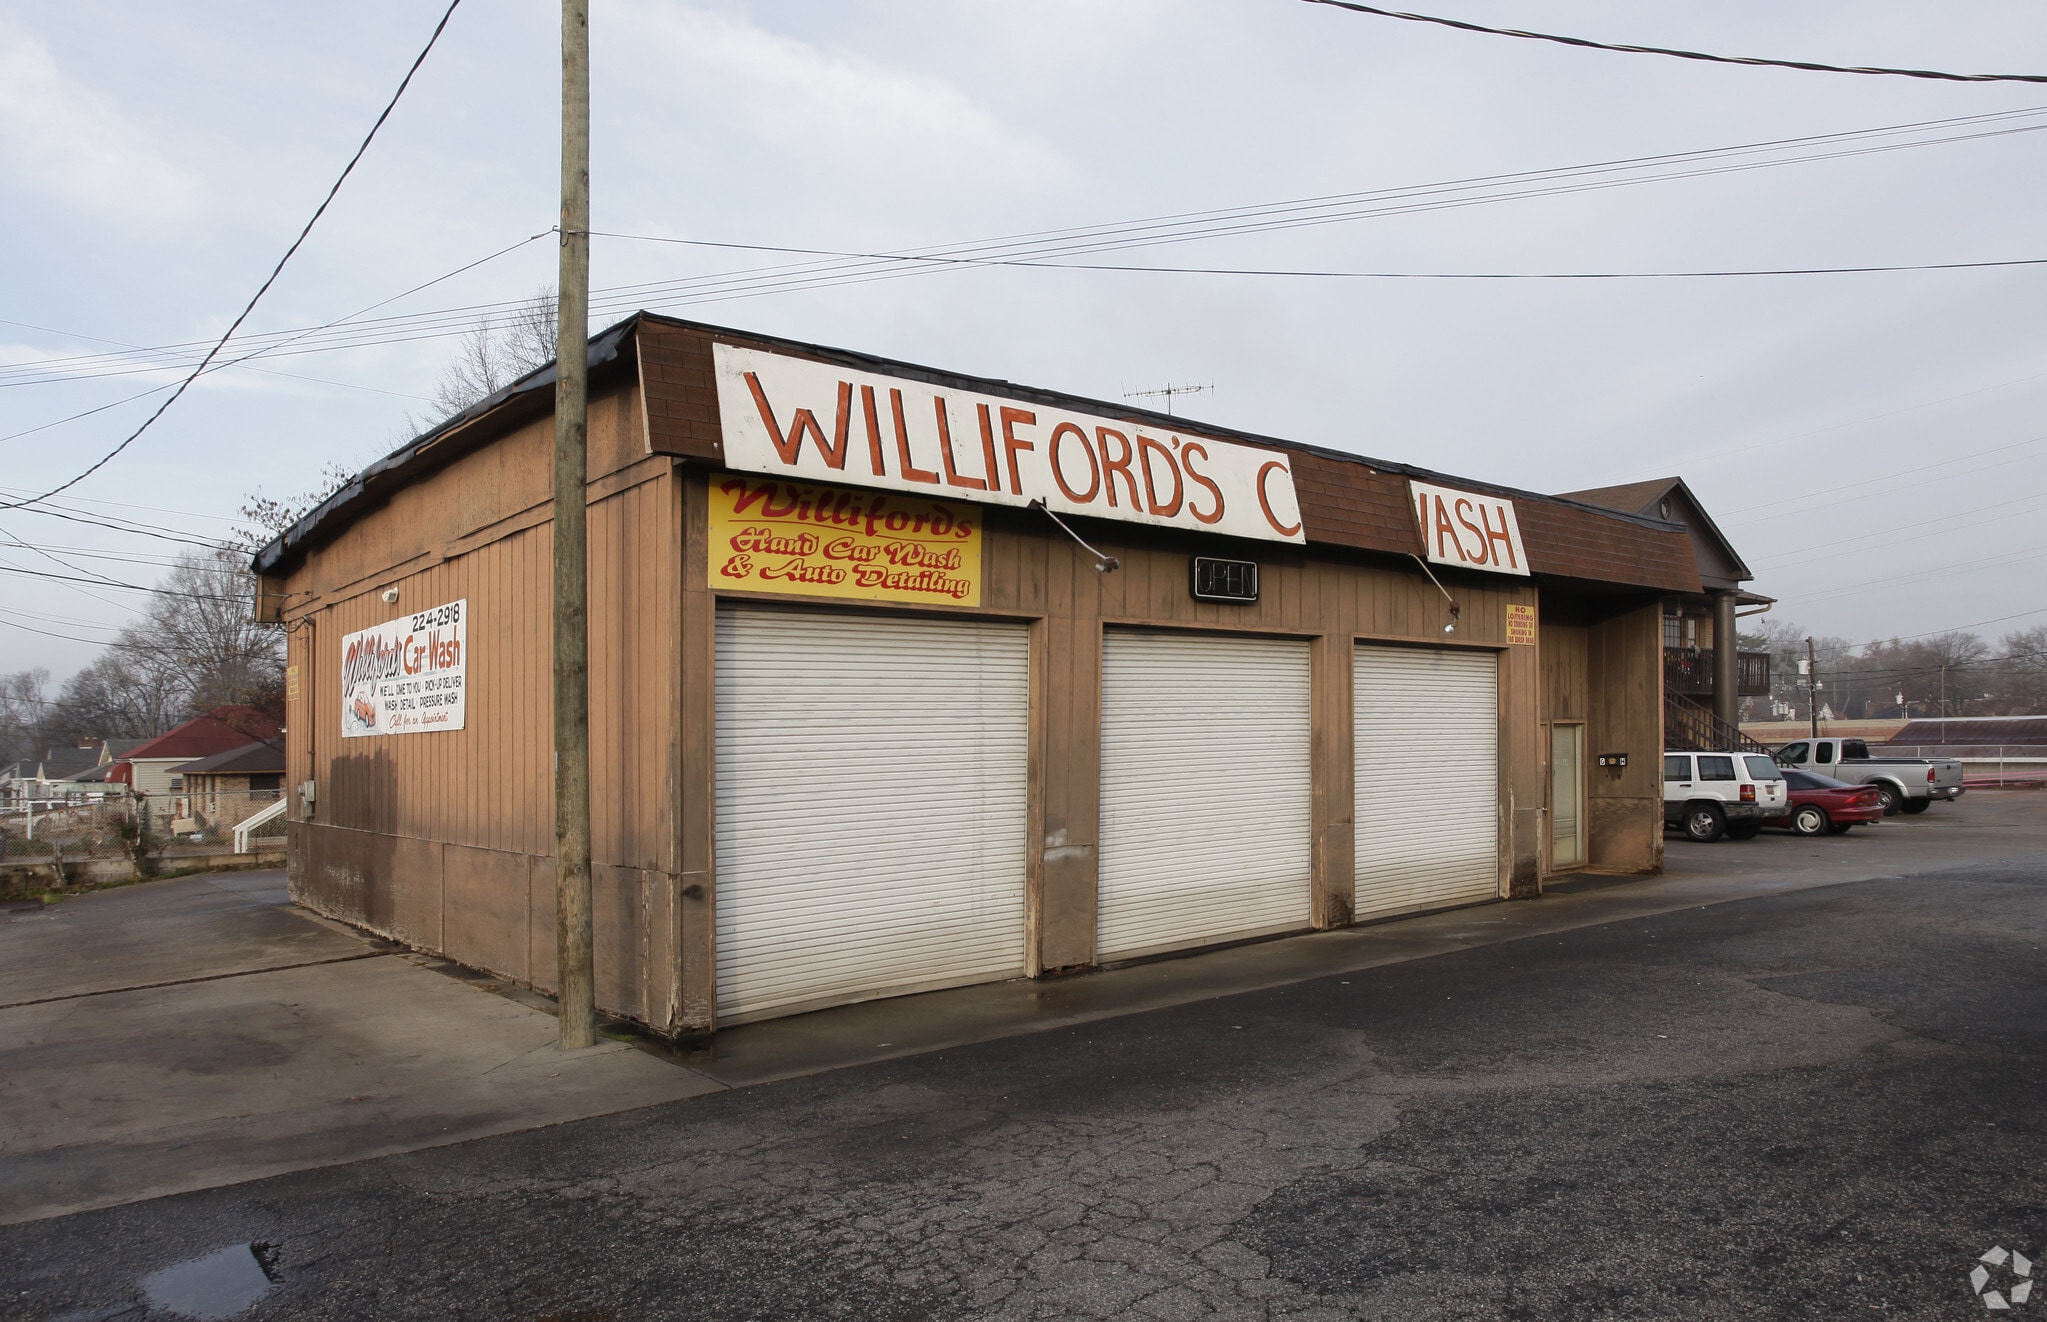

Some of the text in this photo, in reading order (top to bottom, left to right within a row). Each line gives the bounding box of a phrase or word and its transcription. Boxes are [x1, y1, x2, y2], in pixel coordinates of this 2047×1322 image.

[743, 371, 1225, 525] WILLIFORD'S
[1419, 492, 1518, 570] ASH
[730, 526, 962, 571] Hand Car Wash
[720, 553, 972, 599] & Auto Detailing
[1197, 561, 1255, 597] OPEN
[412, 602, 460, 633] 224-2918
[403, 634, 426, 676] Car
[428, 624, 461, 671] Wash
[384, 691, 458, 712] WASH DETAIL PRESSURE WASH
[406, 682, 412, 695] TO
[413, 681, 421, 694] YOU
[424, 677, 442, 693] PICK-UP
[442, 675, 462, 690] DELIVER
[389, 712, 403, 729] Call
[403, 713, 411, 731] for
[421, 711, 449, 730] Appointment
